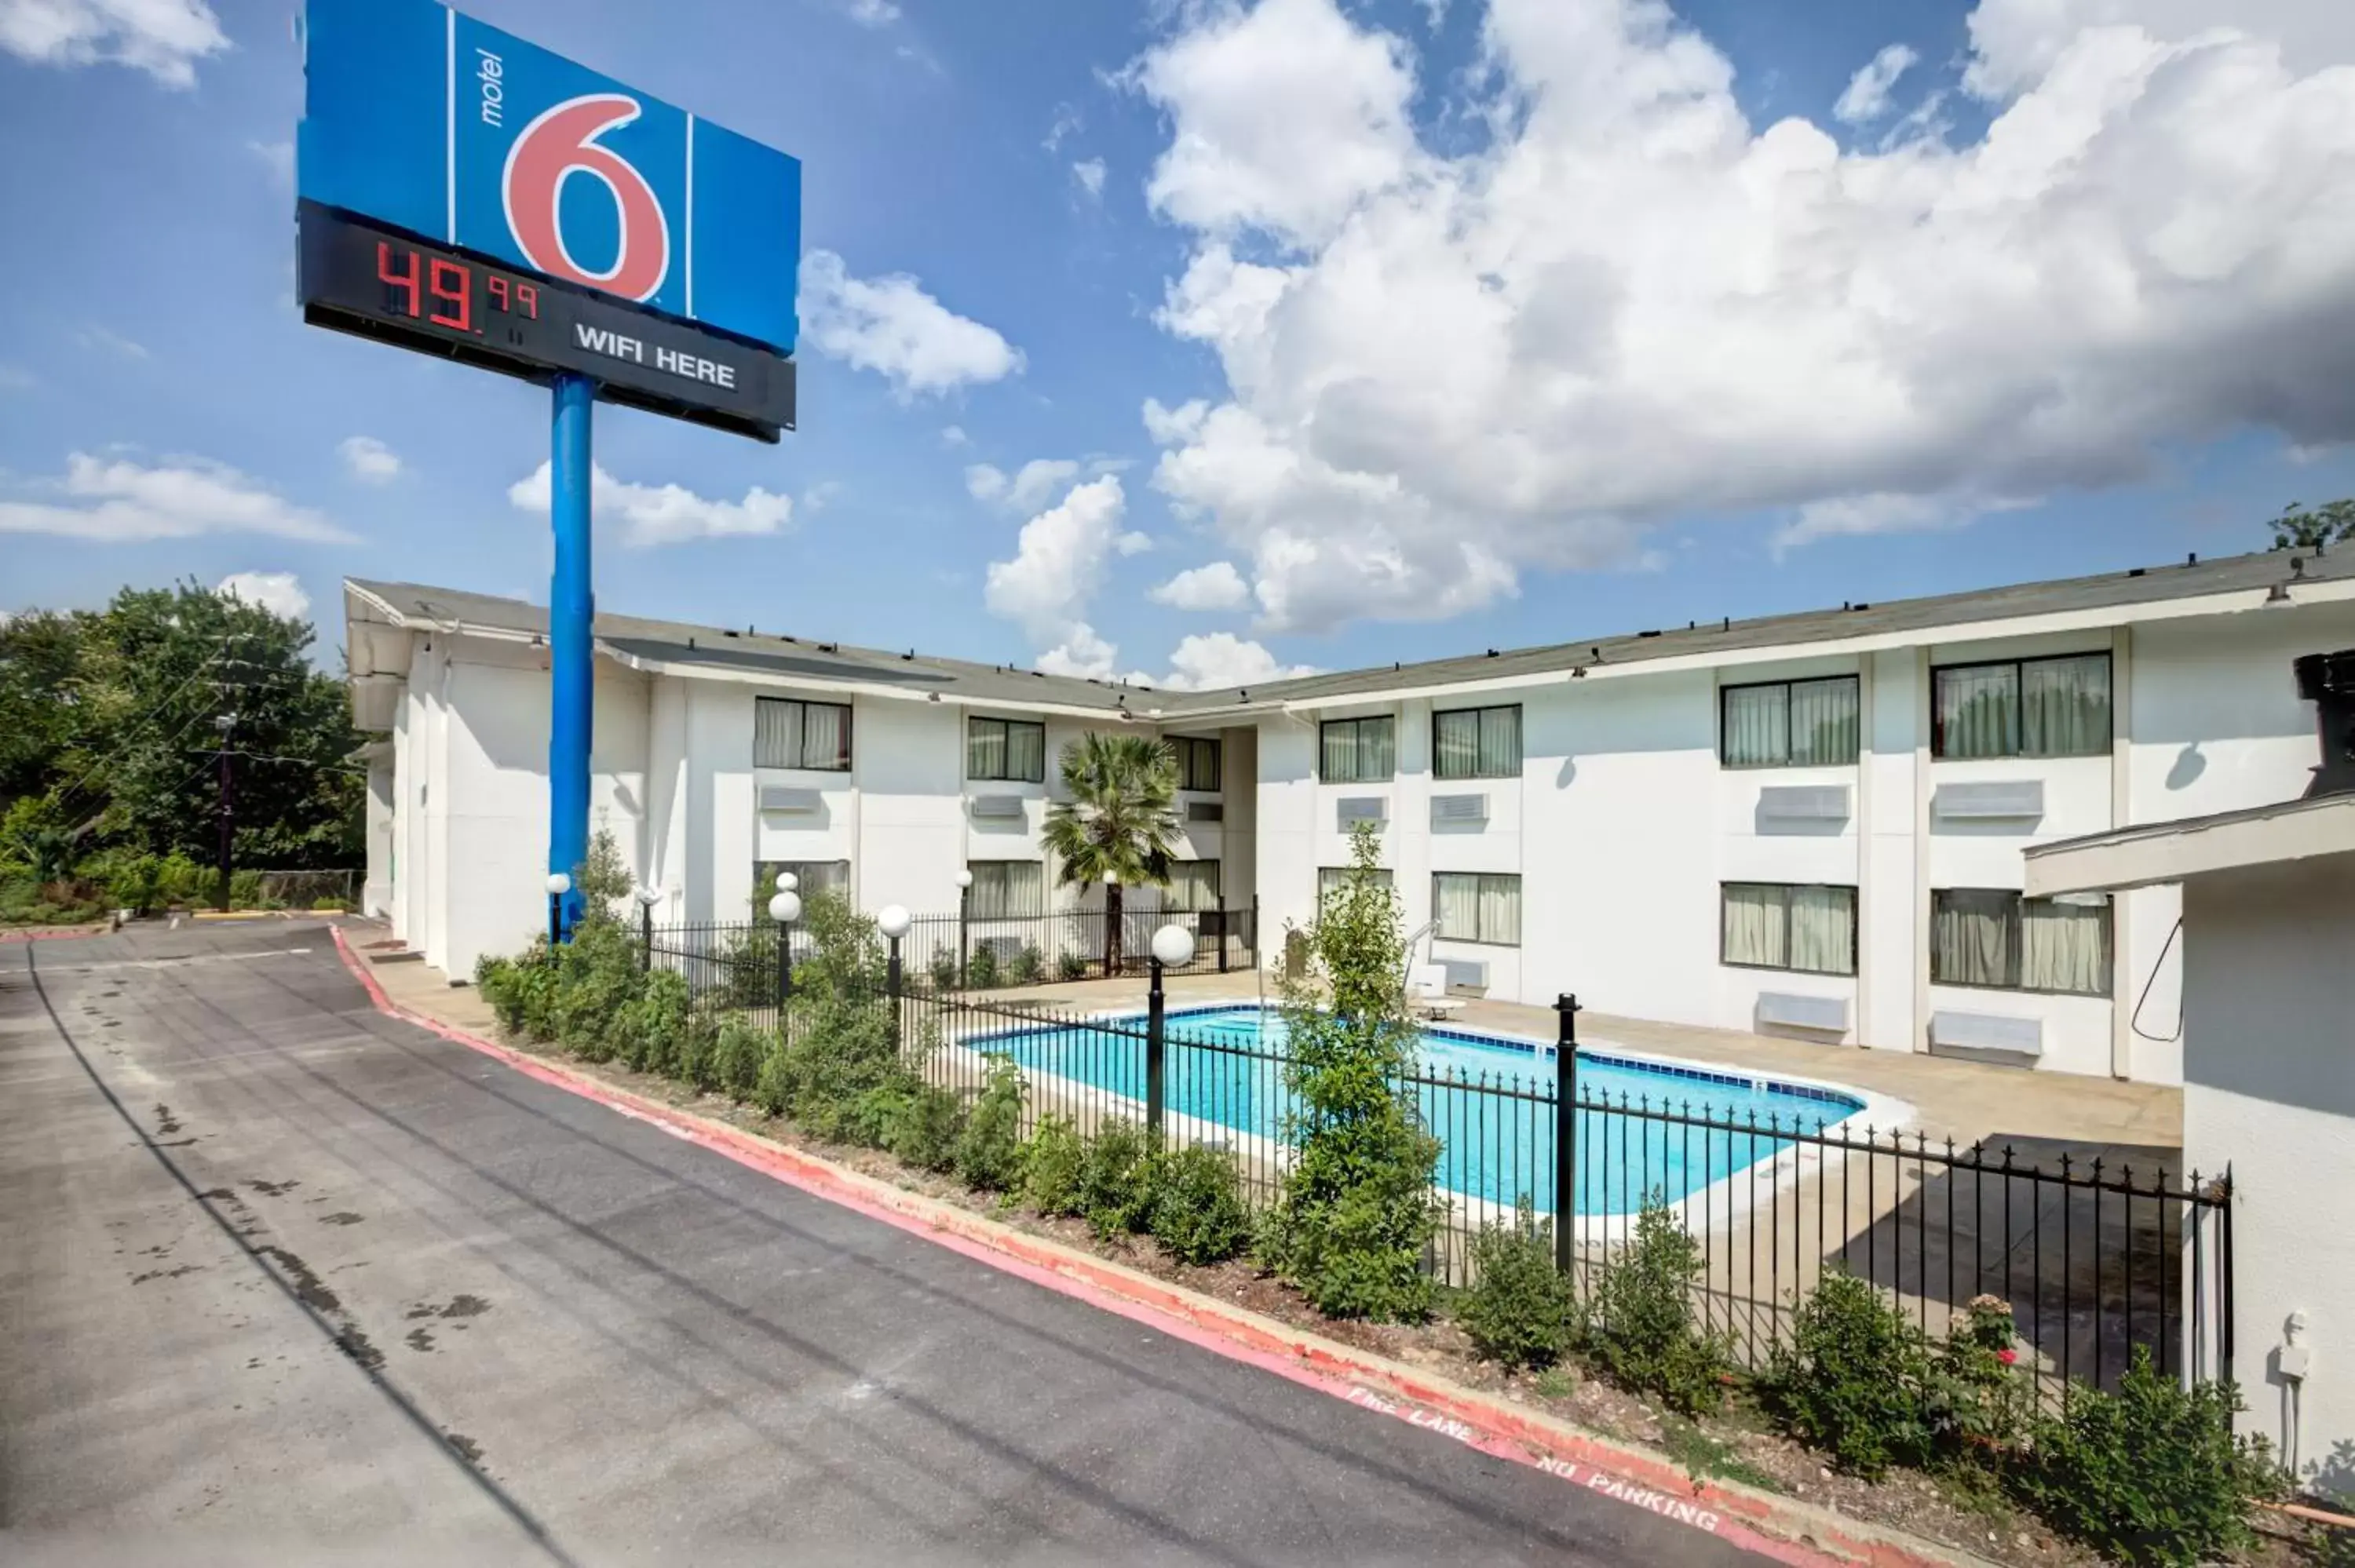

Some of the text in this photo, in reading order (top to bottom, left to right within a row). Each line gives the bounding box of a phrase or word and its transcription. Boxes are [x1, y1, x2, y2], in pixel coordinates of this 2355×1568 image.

[475, 47, 503, 127] motel
[501, 93, 670, 303] 6
[576, 323, 736, 389] WIFI HERE
[1408, 1409, 1473, 1442] LANE
[1536, 1456, 1577, 1477] NO
[1587, 1472, 1719, 1531] PARKING
